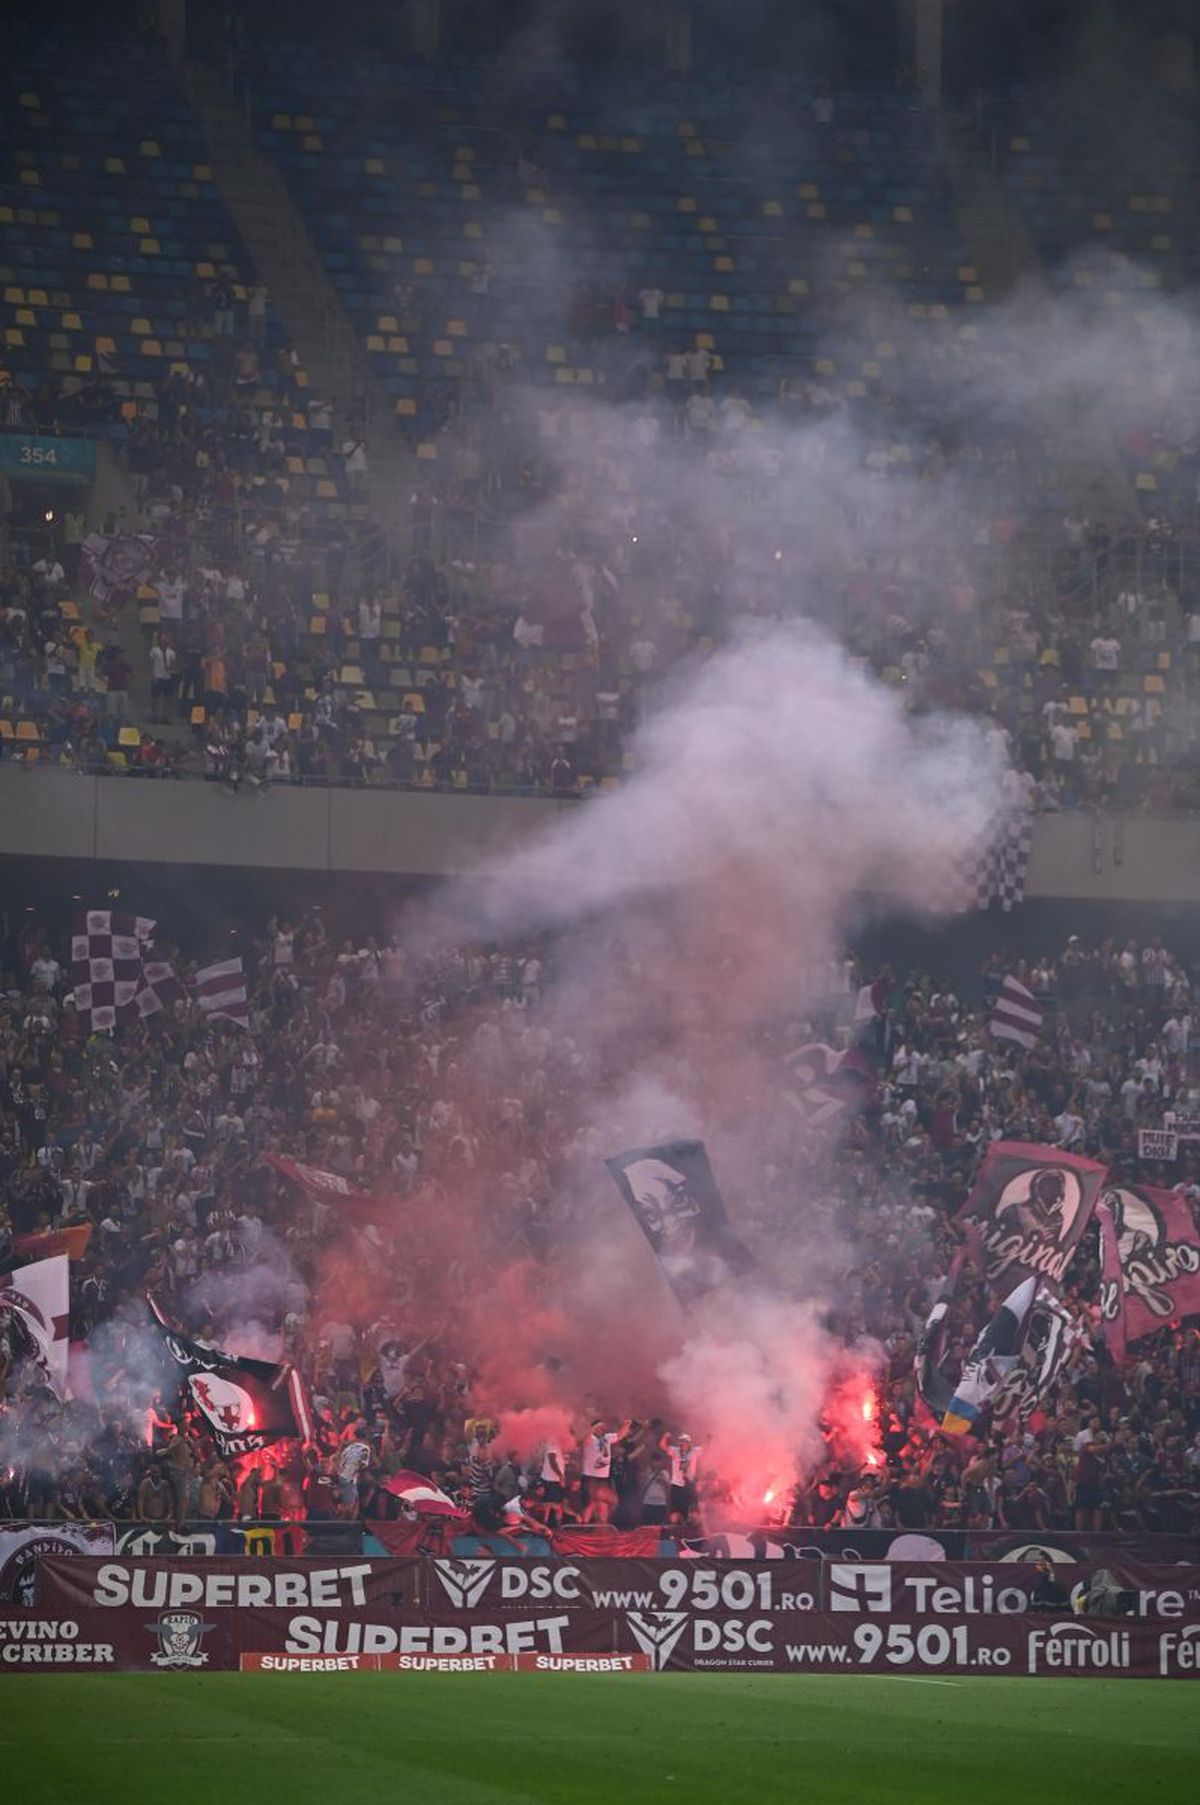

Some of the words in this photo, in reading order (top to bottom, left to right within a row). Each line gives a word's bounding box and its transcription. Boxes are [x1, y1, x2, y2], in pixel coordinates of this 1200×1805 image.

[20, 446, 58, 464] 354
[93, 1563, 373, 1608] SUPERBET
[501, 1566, 581, 1599] DSC
[904, 1574, 1036, 1615] Telio
[284, 1615, 570, 1655] SUPERBET
[693, 1619, 775, 1653] DSC
[1027, 1627, 1130, 1674] Ferroli
[0, 1643, 115, 1663] CRIBER
[260, 1655, 361, 1672] SUPERBET
[398, 1655, 497, 1672] SUPERBET
[535, 1655, 633, 1672] SUPERBET
